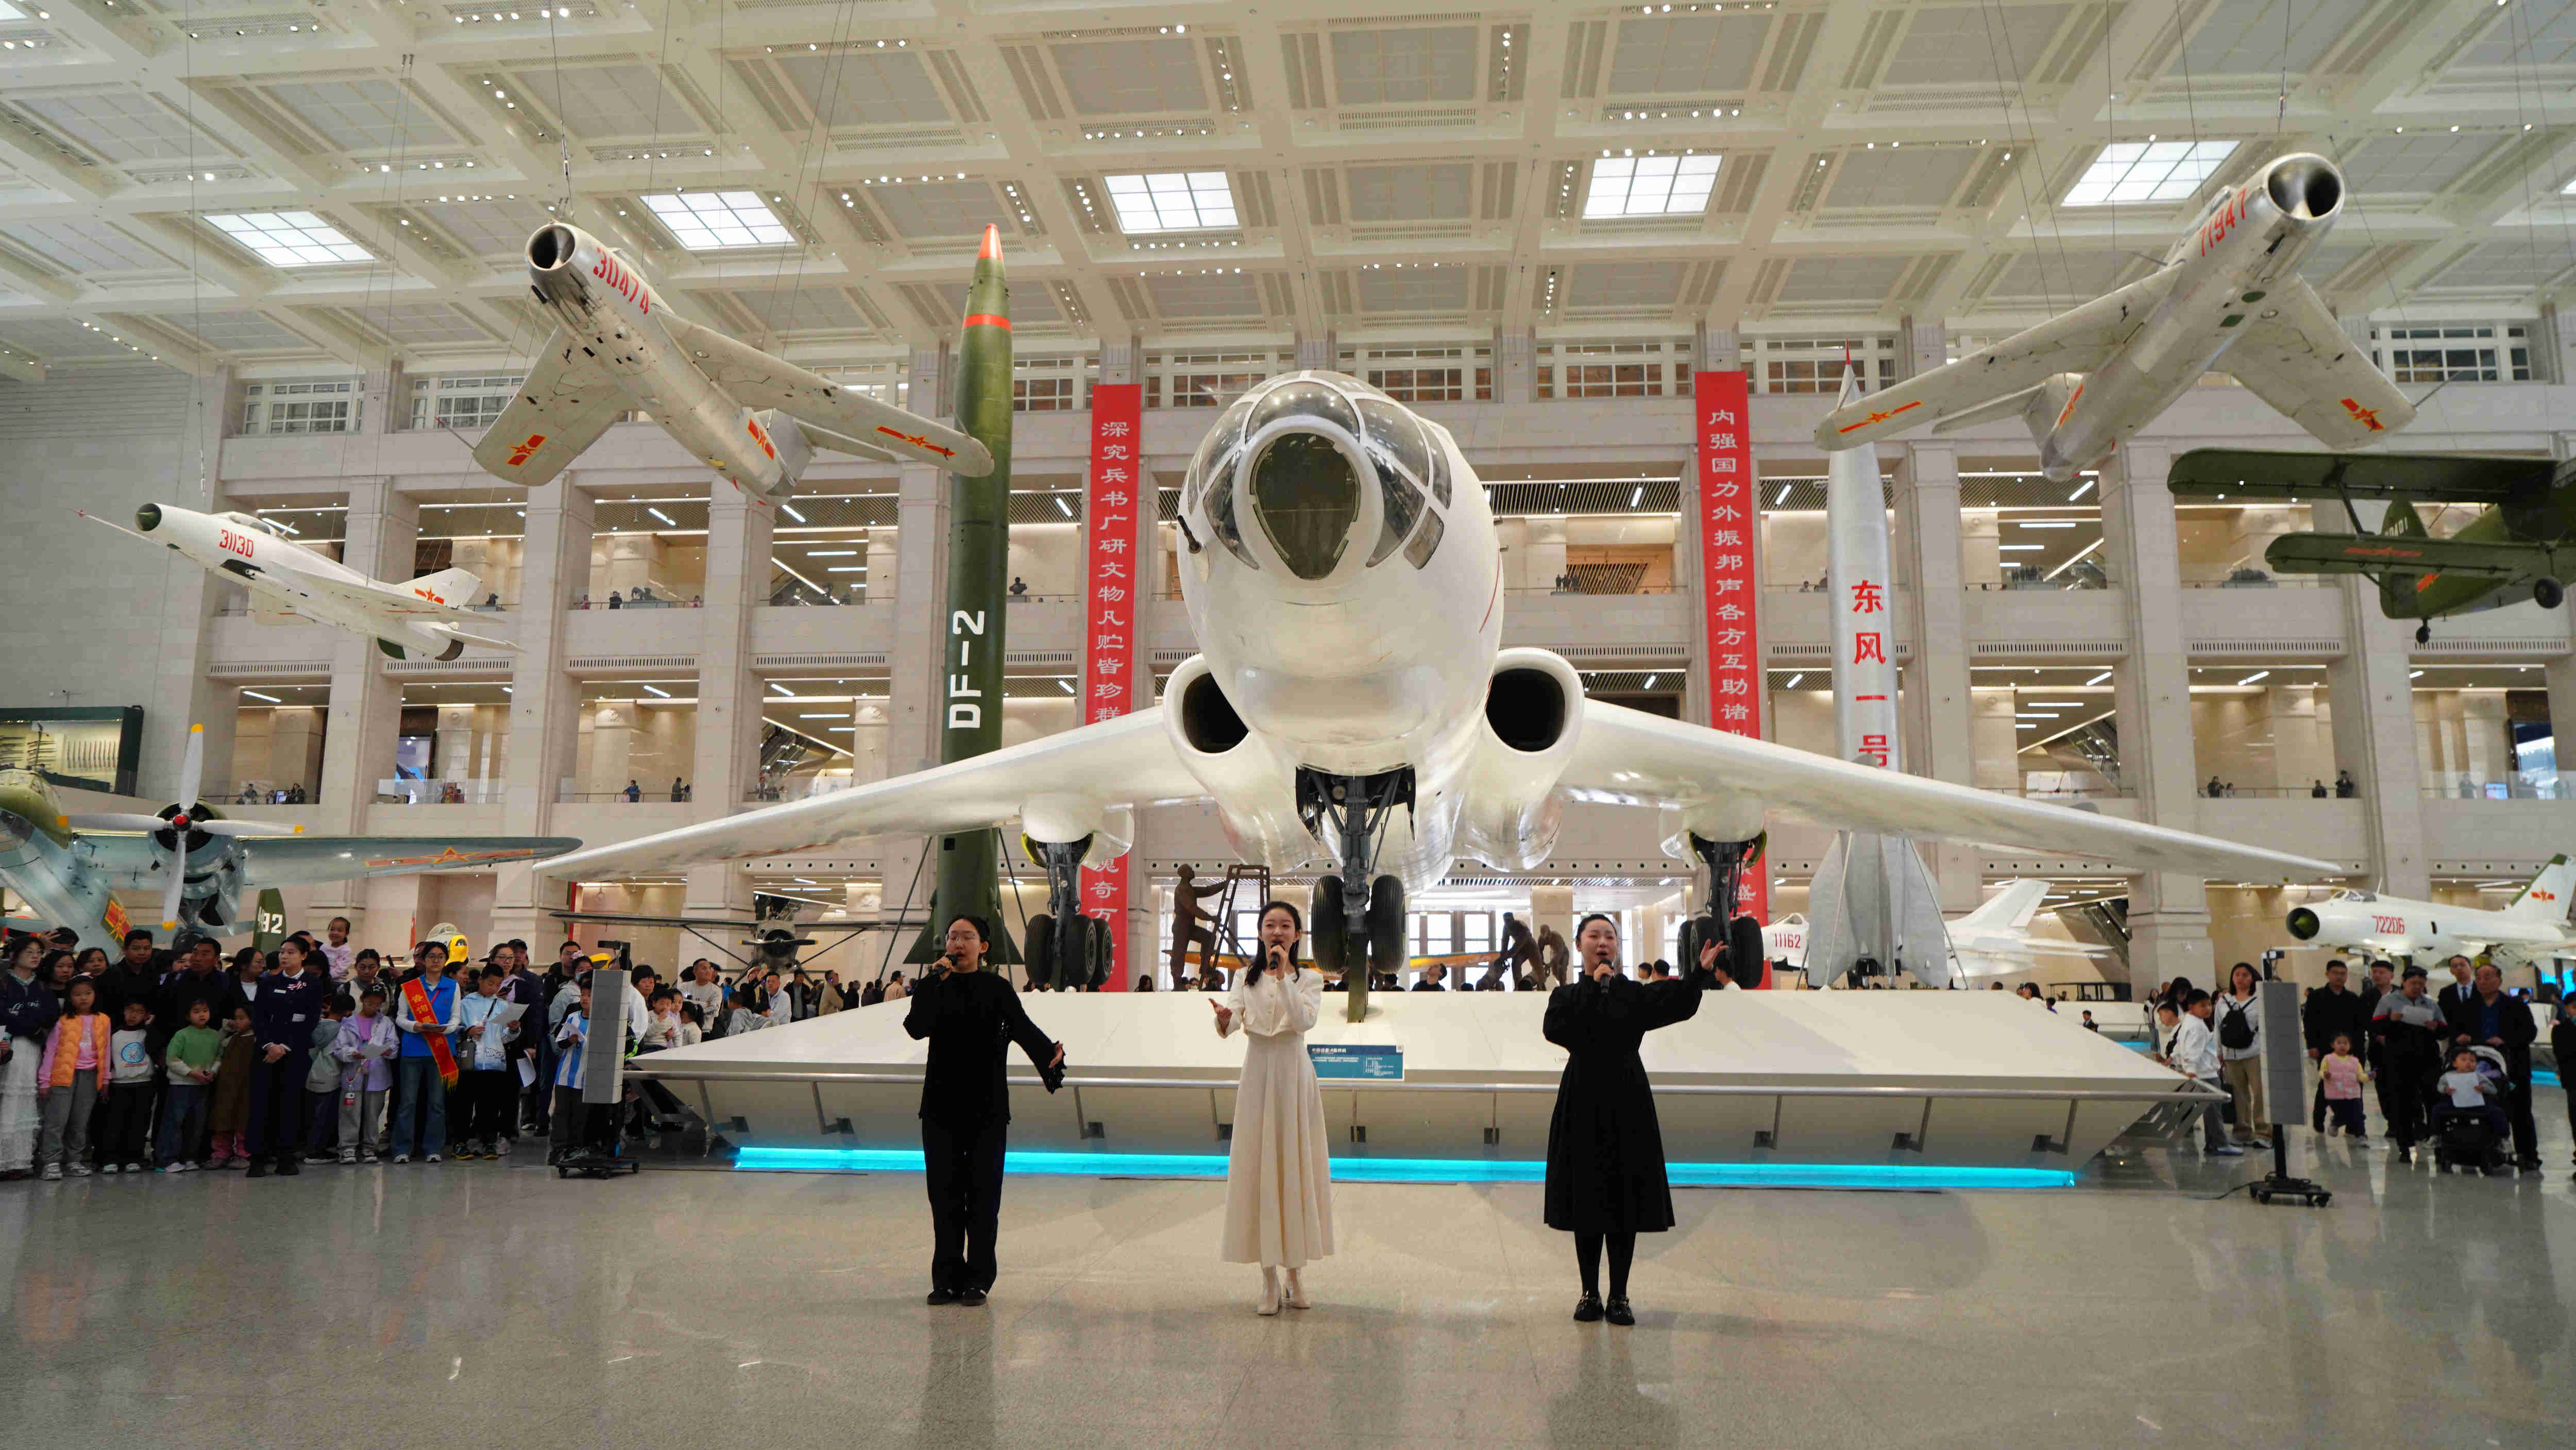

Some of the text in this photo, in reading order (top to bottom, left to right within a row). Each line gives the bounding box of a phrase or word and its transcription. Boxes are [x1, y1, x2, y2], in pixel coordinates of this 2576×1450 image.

[593, 247, 648, 314] 30474
[219, 529, 253, 558] 31130
[1708, 410, 1750, 737] 内强国力外振邦声各方互助诸
[948, 610, 985, 729] DF-2
[1852, 580, 1891, 767] 东风一号
[1774, 933, 1801, 948] 11162
[2371, 915, 2405, 934] 72206
